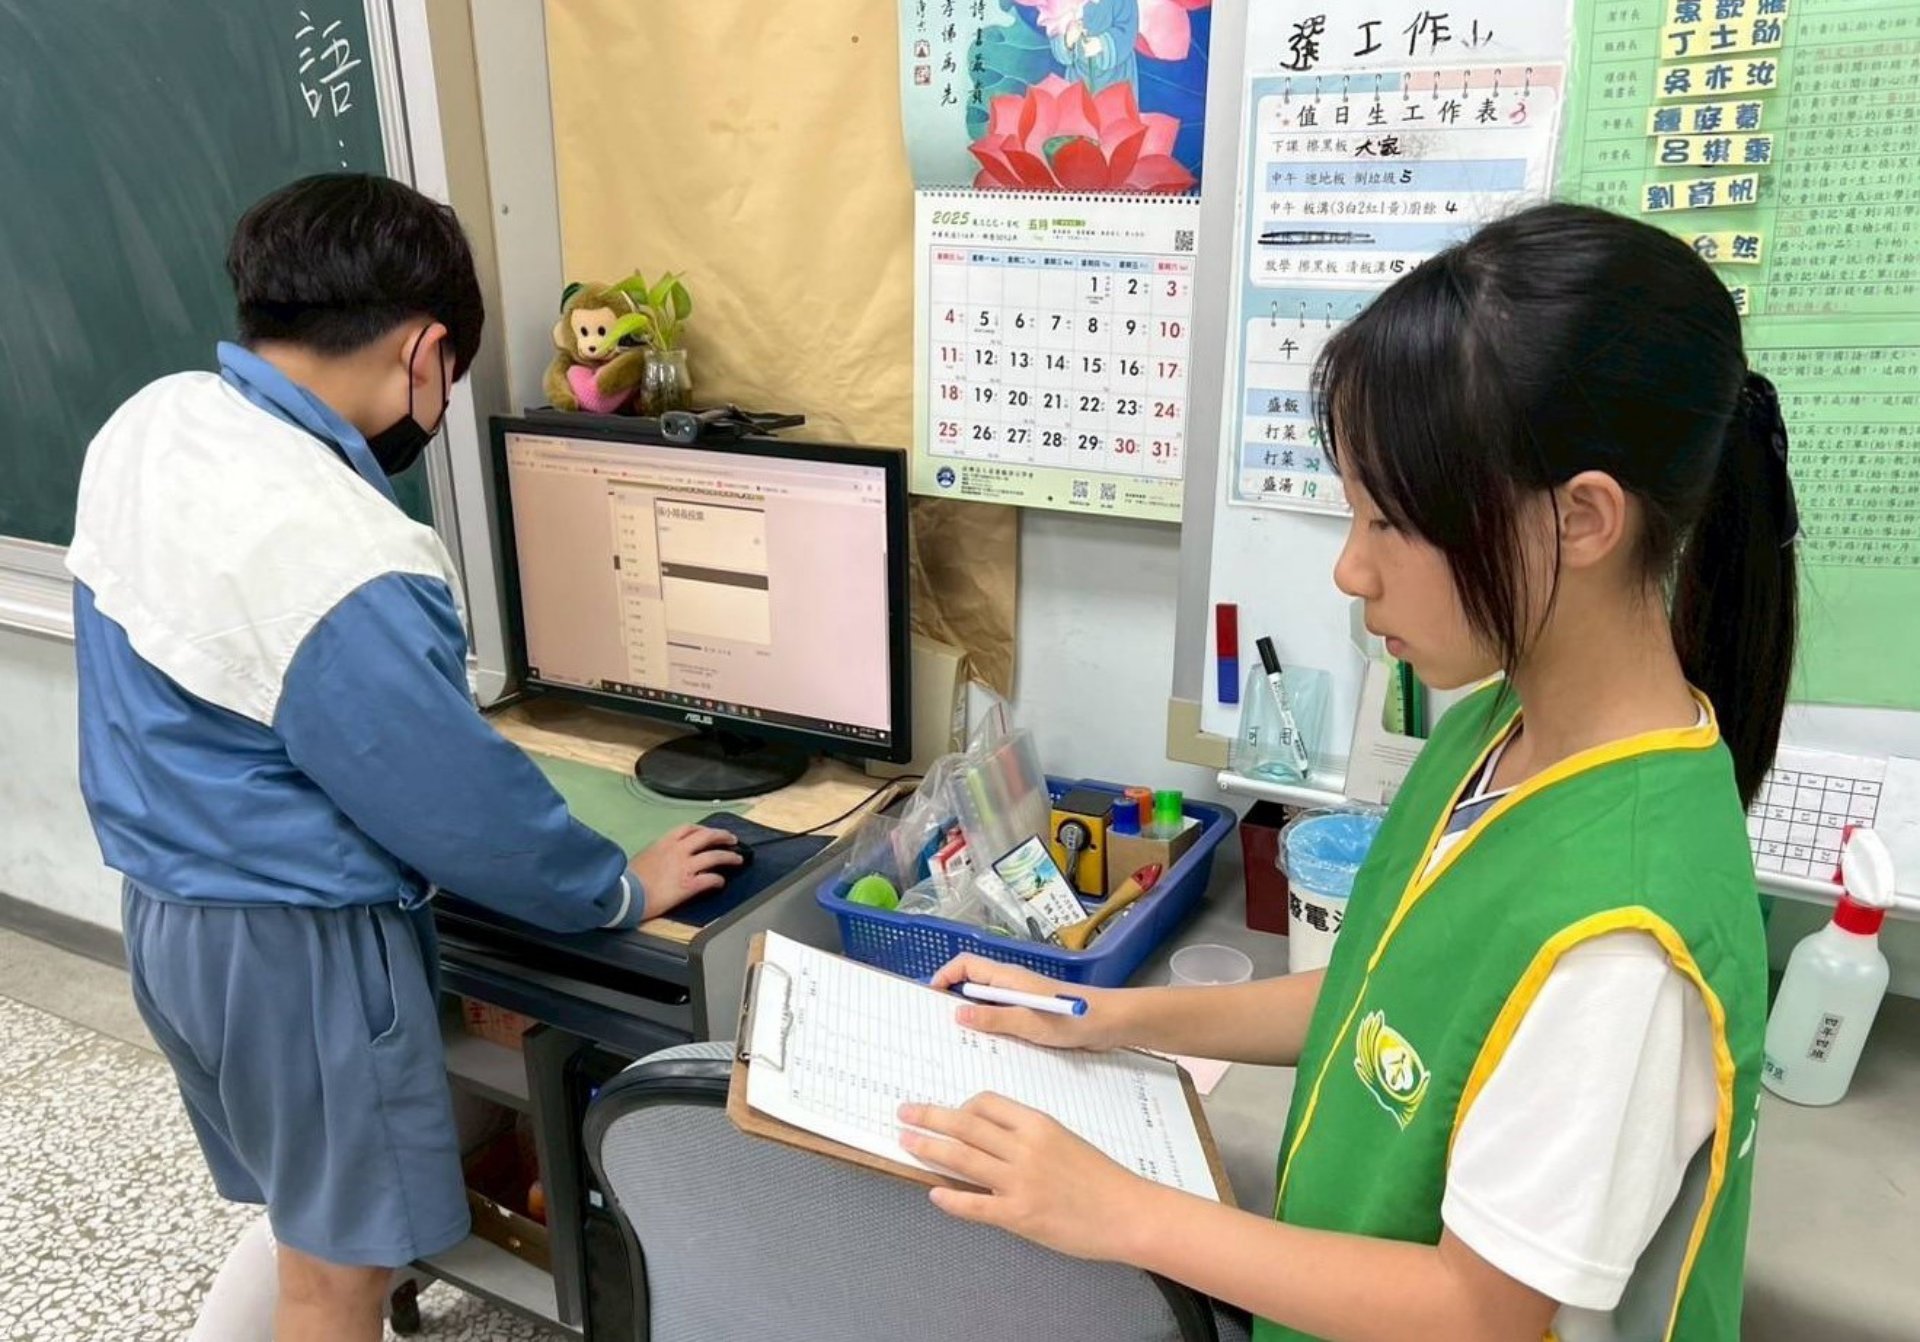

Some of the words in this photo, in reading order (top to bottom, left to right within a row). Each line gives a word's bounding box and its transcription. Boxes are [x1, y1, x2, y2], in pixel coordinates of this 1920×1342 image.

[1668, 18, 1780, 55] 丁士勛
[1296, 98, 1498, 127] 值日生工作表
[1272, 173, 1297, 185] 中午
[1399, 169, 1412, 183] 5
[1270, 201, 1295, 215] 中午
[1445, 200, 1457, 213] 4
[932, 211, 970, 225] 2025
[1091, 276, 1097, 292] 1
[1128, 278, 1138, 295] 2
[1167, 280, 1177, 297] 3
[945, 308, 955, 323] 4
[980, 311, 989, 326] 5
[1015, 313, 1025, 329] 6
[1051, 315, 1061, 331] 7
[1088, 317, 1098, 333] 8
[1126, 319, 1136, 335] 9
[1161, 321, 1180, 338] 10
[941, 347, 957, 362] 11
[975, 350, 993, 365] 12
[1010, 352, 1029, 367] 13
[1046, 354, 1065, 370] 14
[1083, 358, 1102, 373] 15
[1120, 360, 1140, 376] 16
[1158, 362, 1177, 378] 17
[940, 385, 959, 400] 18
[975, 387, 993, 402] 19
[1008, 391, 1028, 406] 20
[1043, 394, 1061, 409] 21
[1079, 397, 1100, 412] 22
[1117, 400, 1137, 415] 23
[1267, 396, 1299, 414] 盛飯
[1154, 402, 1175, 418] 24
[939, 422, 958, 437] 25
[973, 425, 992, 440] 26
[1007, 428, 1027, 443] 27
[1265, 424, 1296, 441] 打菜
[1042, 431, 1062, 447] 28
[1078, 435, 1099, 450] 29
[1115, 438, 1136, 454] 30
[1152, 441, 1171, 457] 31
[1264, 450, 1294, 467] 打菜
[1262, 475, 1293, 493] 盛湯
[1302, 480, 1317, 498] 19
[685, 713, 713, 725] ASUS
